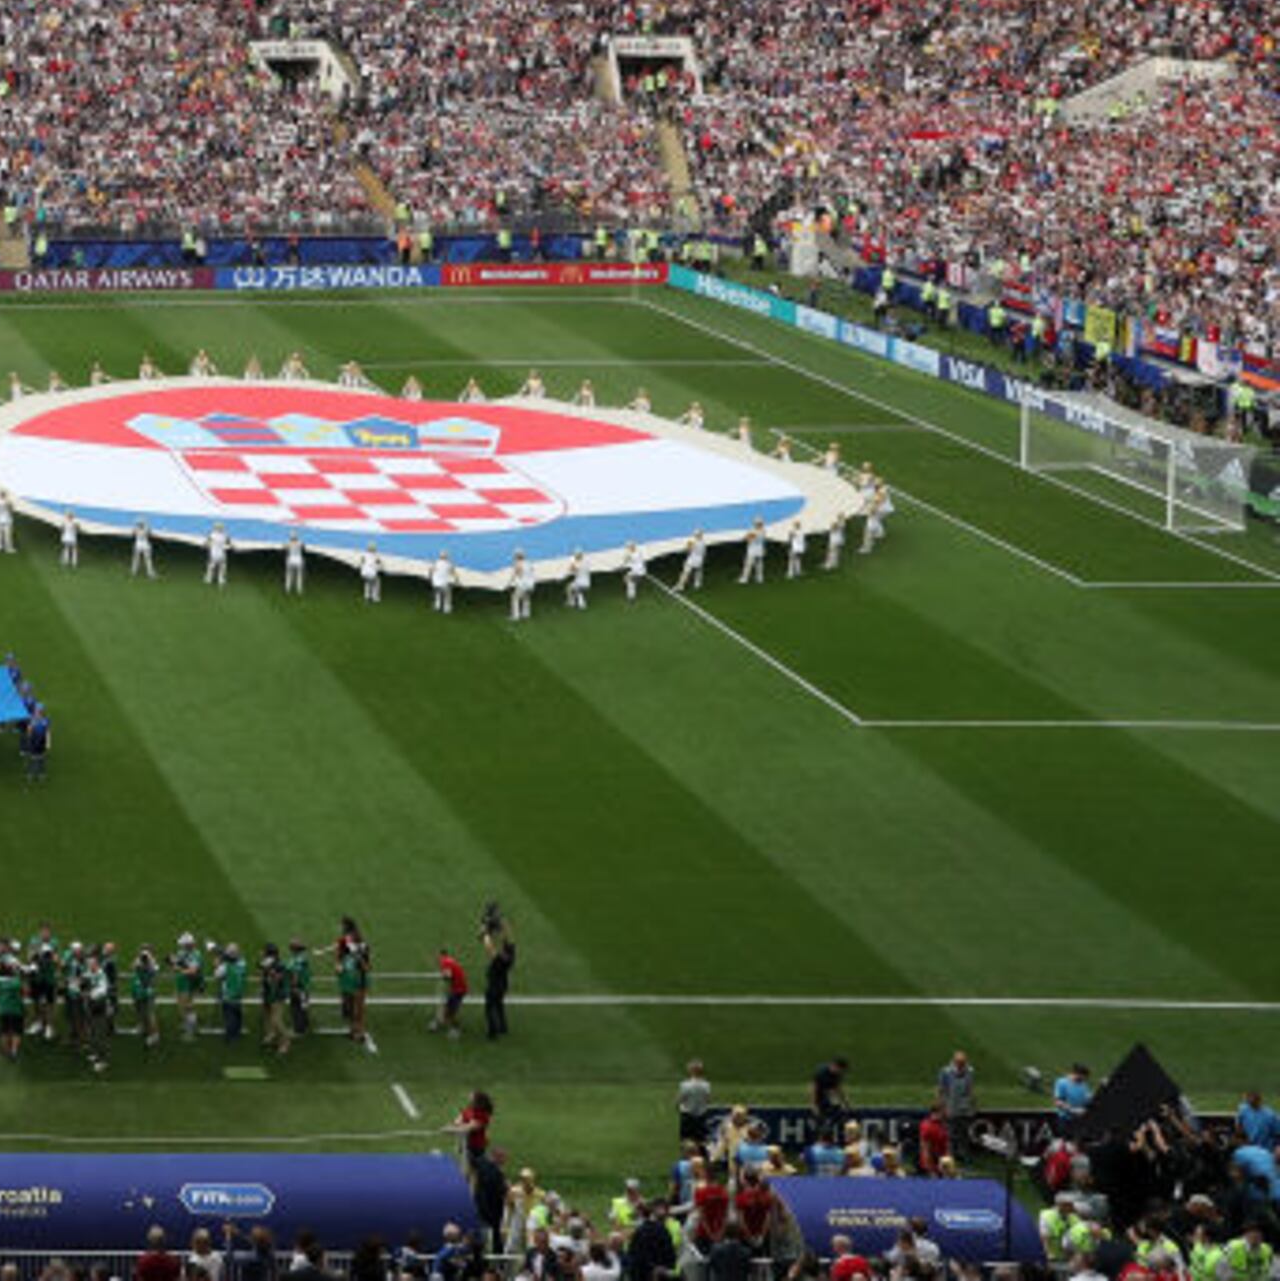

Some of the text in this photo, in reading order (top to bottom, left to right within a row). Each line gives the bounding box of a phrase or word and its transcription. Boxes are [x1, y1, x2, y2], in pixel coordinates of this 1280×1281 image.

[15, 270, 193, 289] QATAR AIRWAYS
[326, 267, 423, 287] WANDA
[948, 357, 986, 389] VISA
